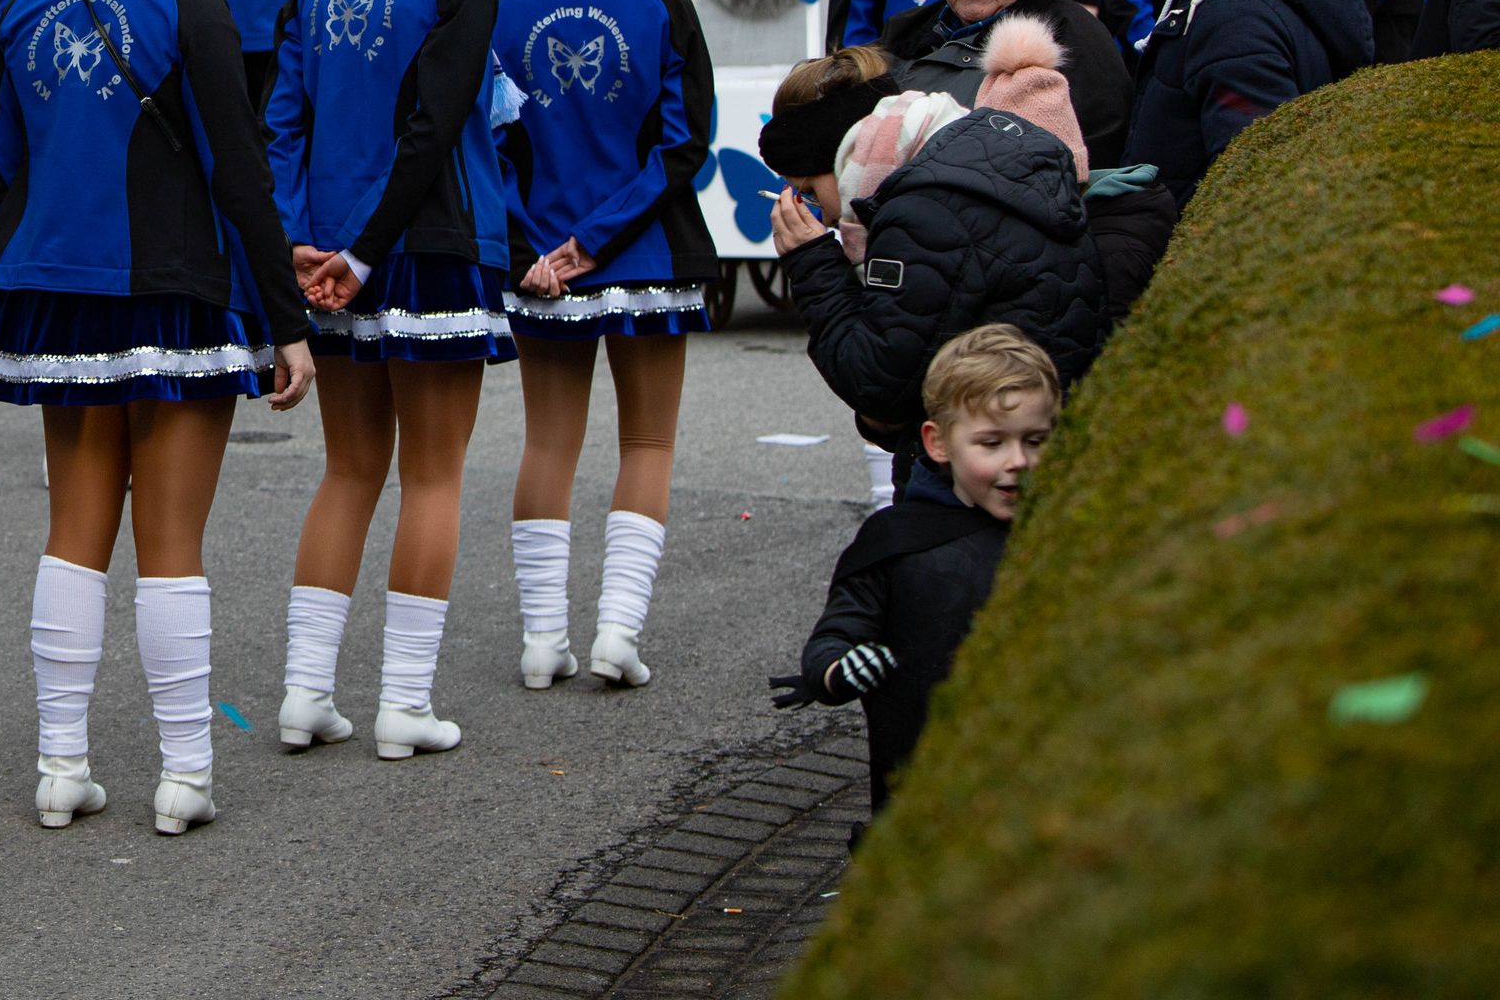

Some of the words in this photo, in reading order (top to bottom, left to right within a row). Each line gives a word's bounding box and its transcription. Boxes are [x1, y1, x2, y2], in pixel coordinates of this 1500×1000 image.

[364, 36, 384, 61] e.V.
[522, 6, 583, 80] Schmetterling
[588, 6, 630, 73] Wallendorf
[32, 79, 52, 101] KV
[96, 74, 122, 100] e.V.
[532, 89, 553, 108] KV
[604, 80, 623, 102] e.V.
